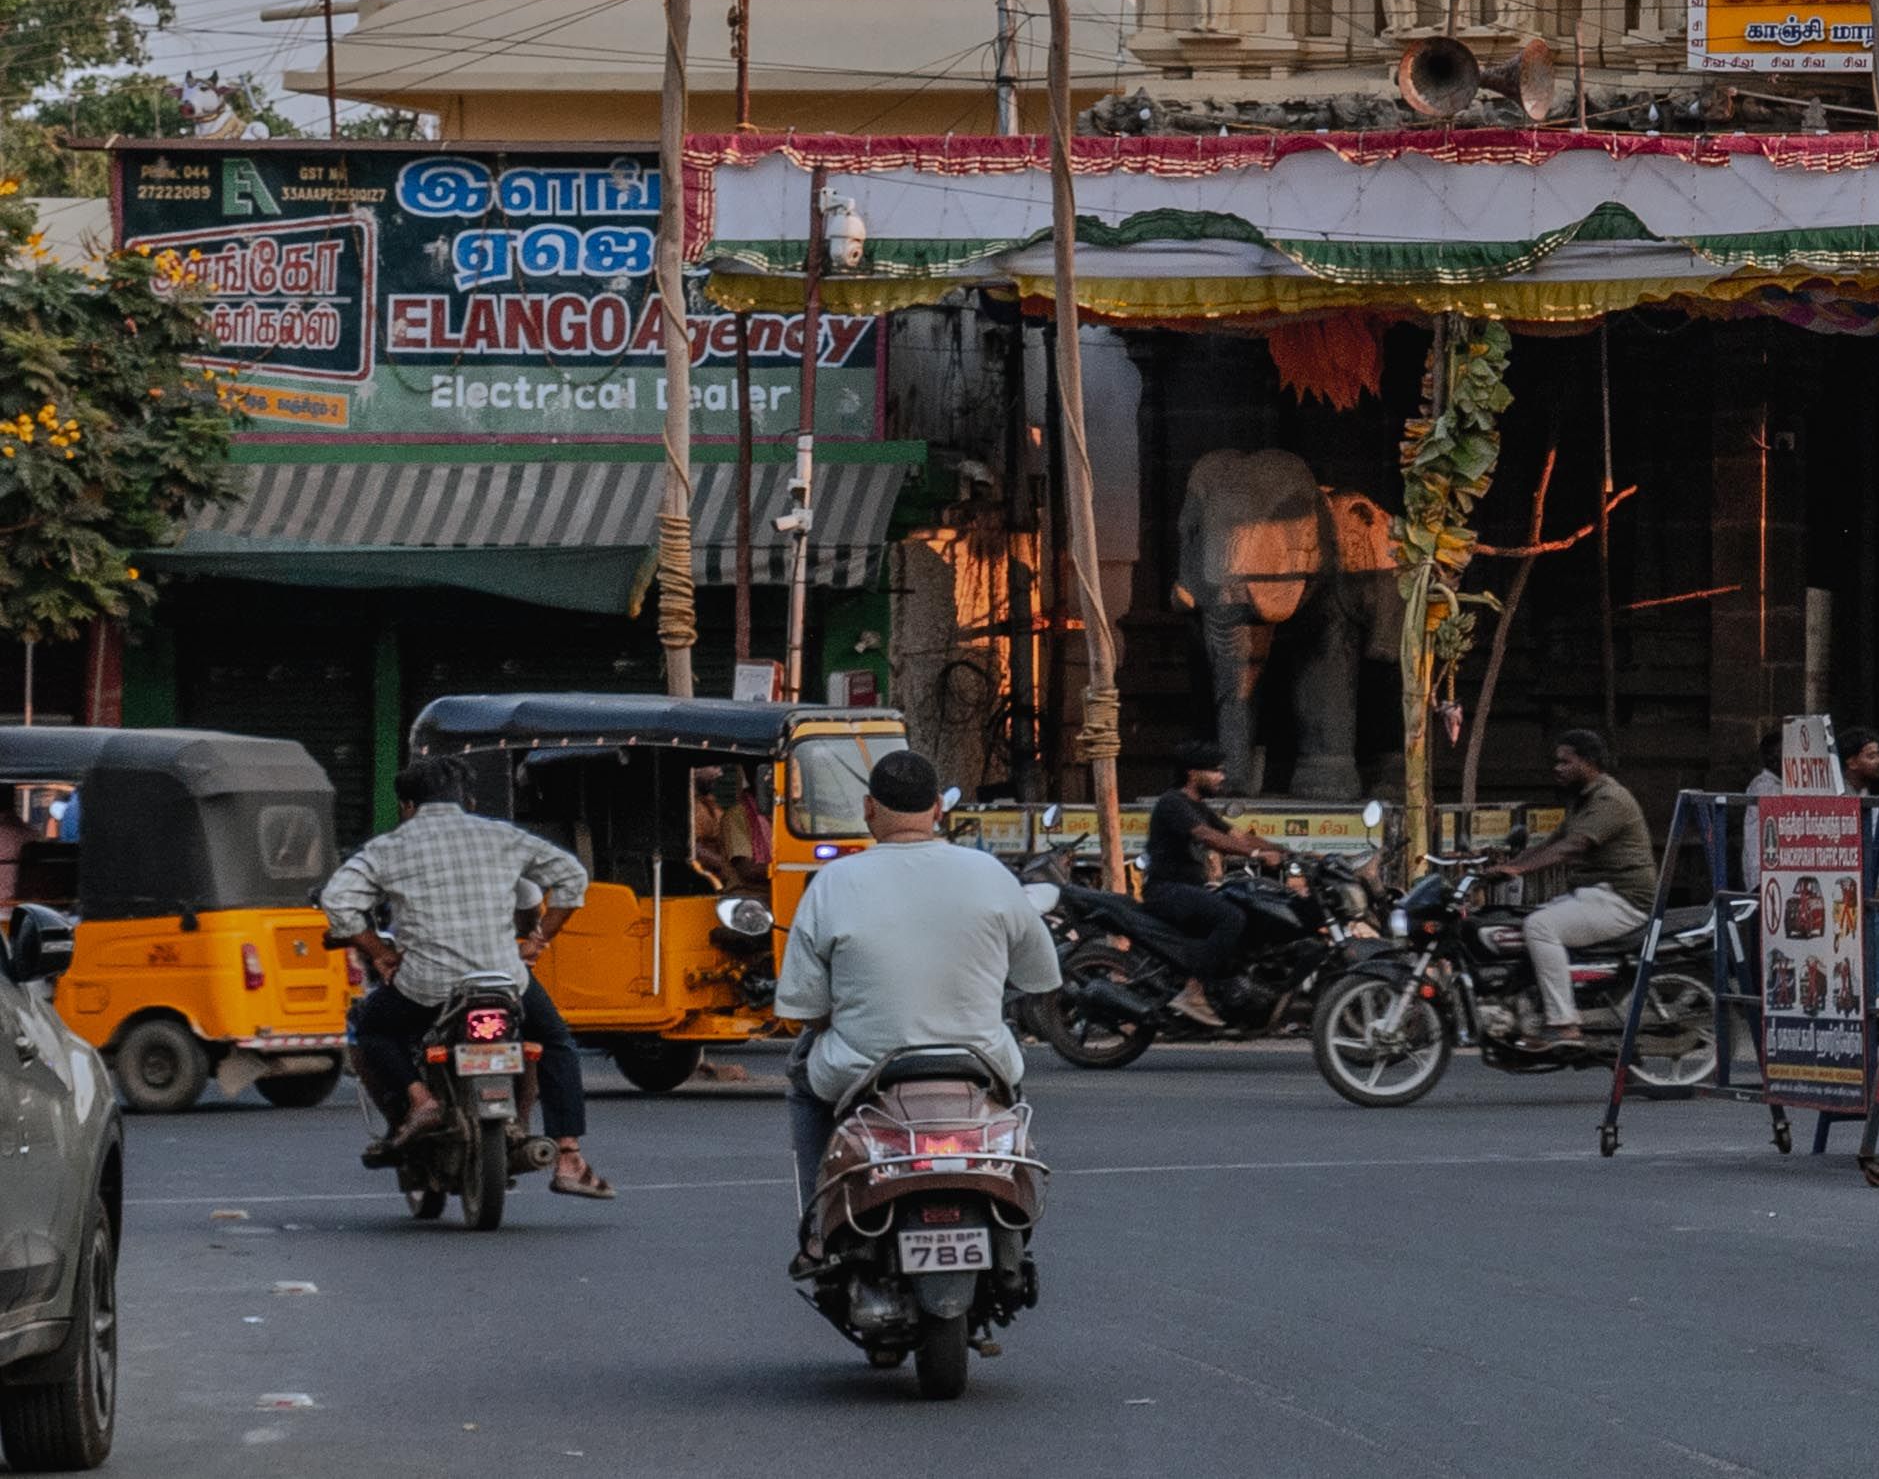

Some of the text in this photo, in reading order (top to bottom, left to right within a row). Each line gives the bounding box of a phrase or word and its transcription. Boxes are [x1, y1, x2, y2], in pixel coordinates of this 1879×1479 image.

[1747, 17, 1822, 45] காஞ்சி
[1702, 56, 1725, 68] சிவ
[1730, 56, 1753, 68] சிவ
[1771, 56, 1794, 68] சிவ
[1802, 56, 1825, 68] சிவ
[1843, 56, 1866, 68] சிவ
[183, 165, 209, 180] 044
[300, 166, 324, 181] GST
[137, 185, 212, 200] 27222089
[388, 294, 630, 354] ELANGO
[430, 373, 636, 410] Electrical
[1784, 757, 1831, 789] NO ENTRY
[911, 1244, 983, 1267] 786
